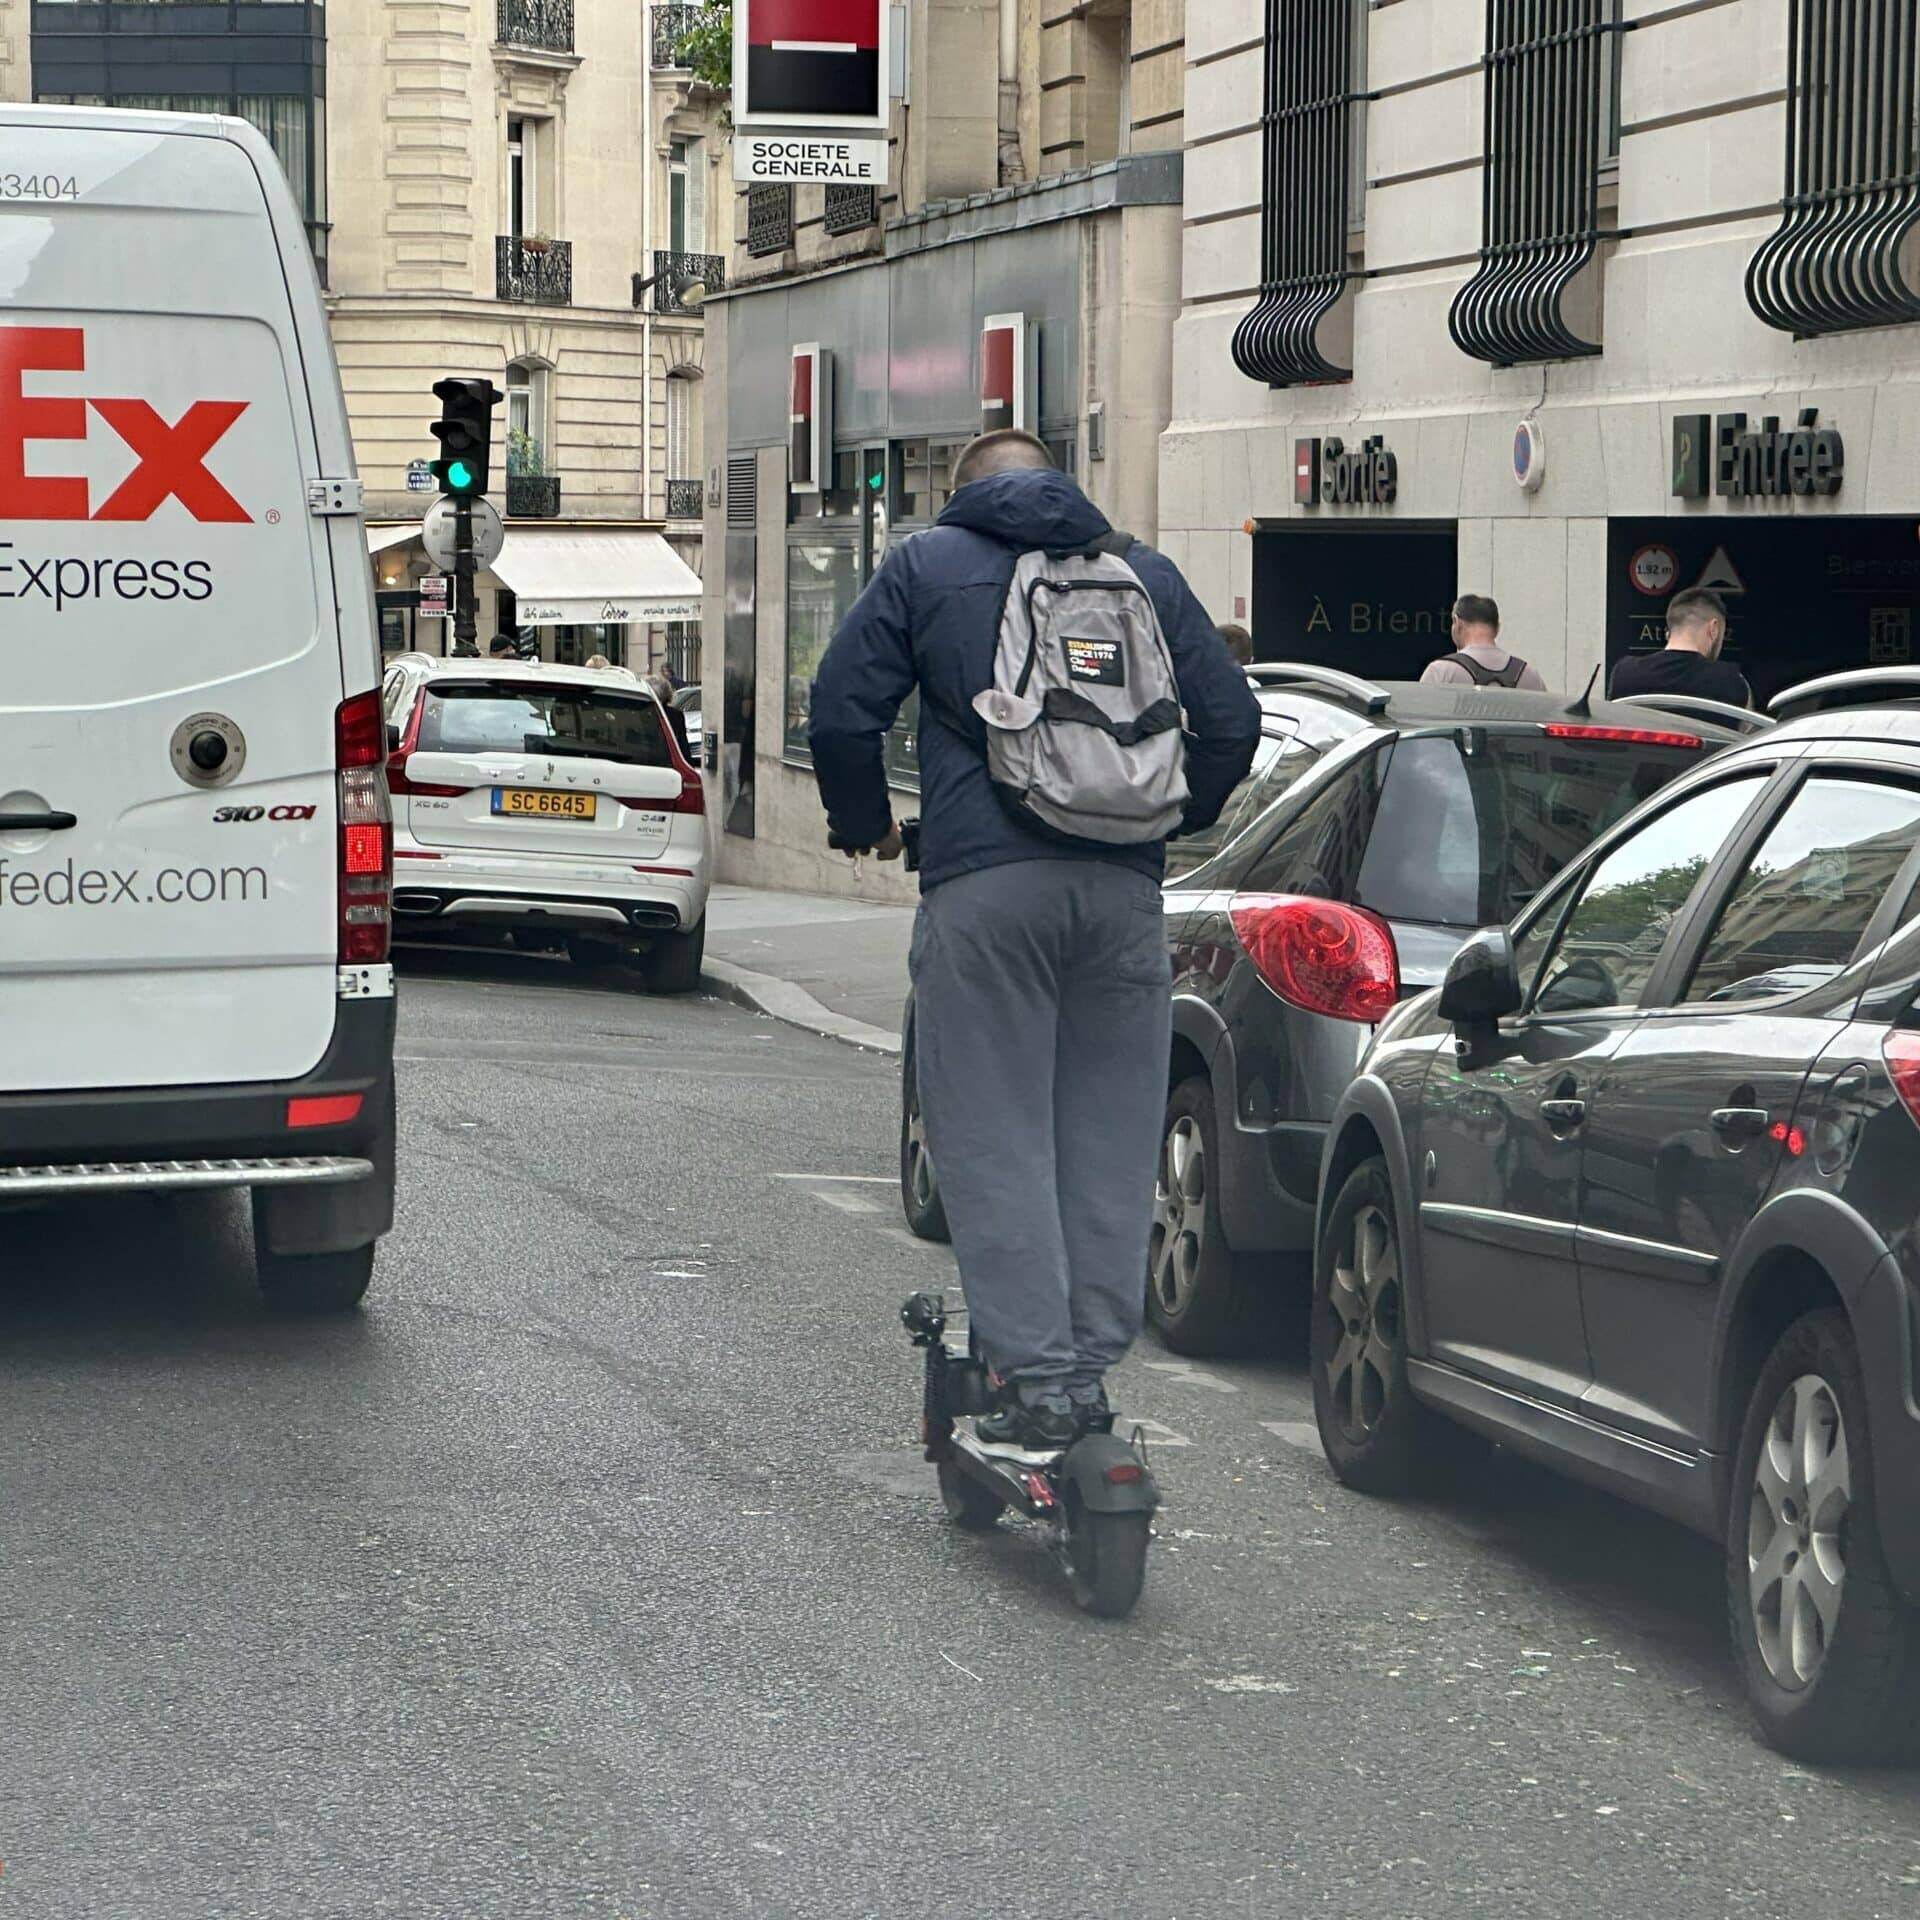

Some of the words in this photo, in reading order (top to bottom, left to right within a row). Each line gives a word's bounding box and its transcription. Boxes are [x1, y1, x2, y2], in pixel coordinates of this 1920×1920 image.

[752, 143, 849, 160] SOCIETE
[752, 160, 871, 178] GENERALE
[0, 174, 80, 200] 3404
[1716, 407, 1844, 496] Entrée
[1321, 435, 1398, 504] Sortie
[1307, 595, 1332, 633] À
[1068, 649, 1093, 659] SINCE
[511, 793, 534, 810] SC
[539, 795, 585, 813] 6645
[213, 805, 266, 823] 310
[268, 804, 317, 821] CDI
